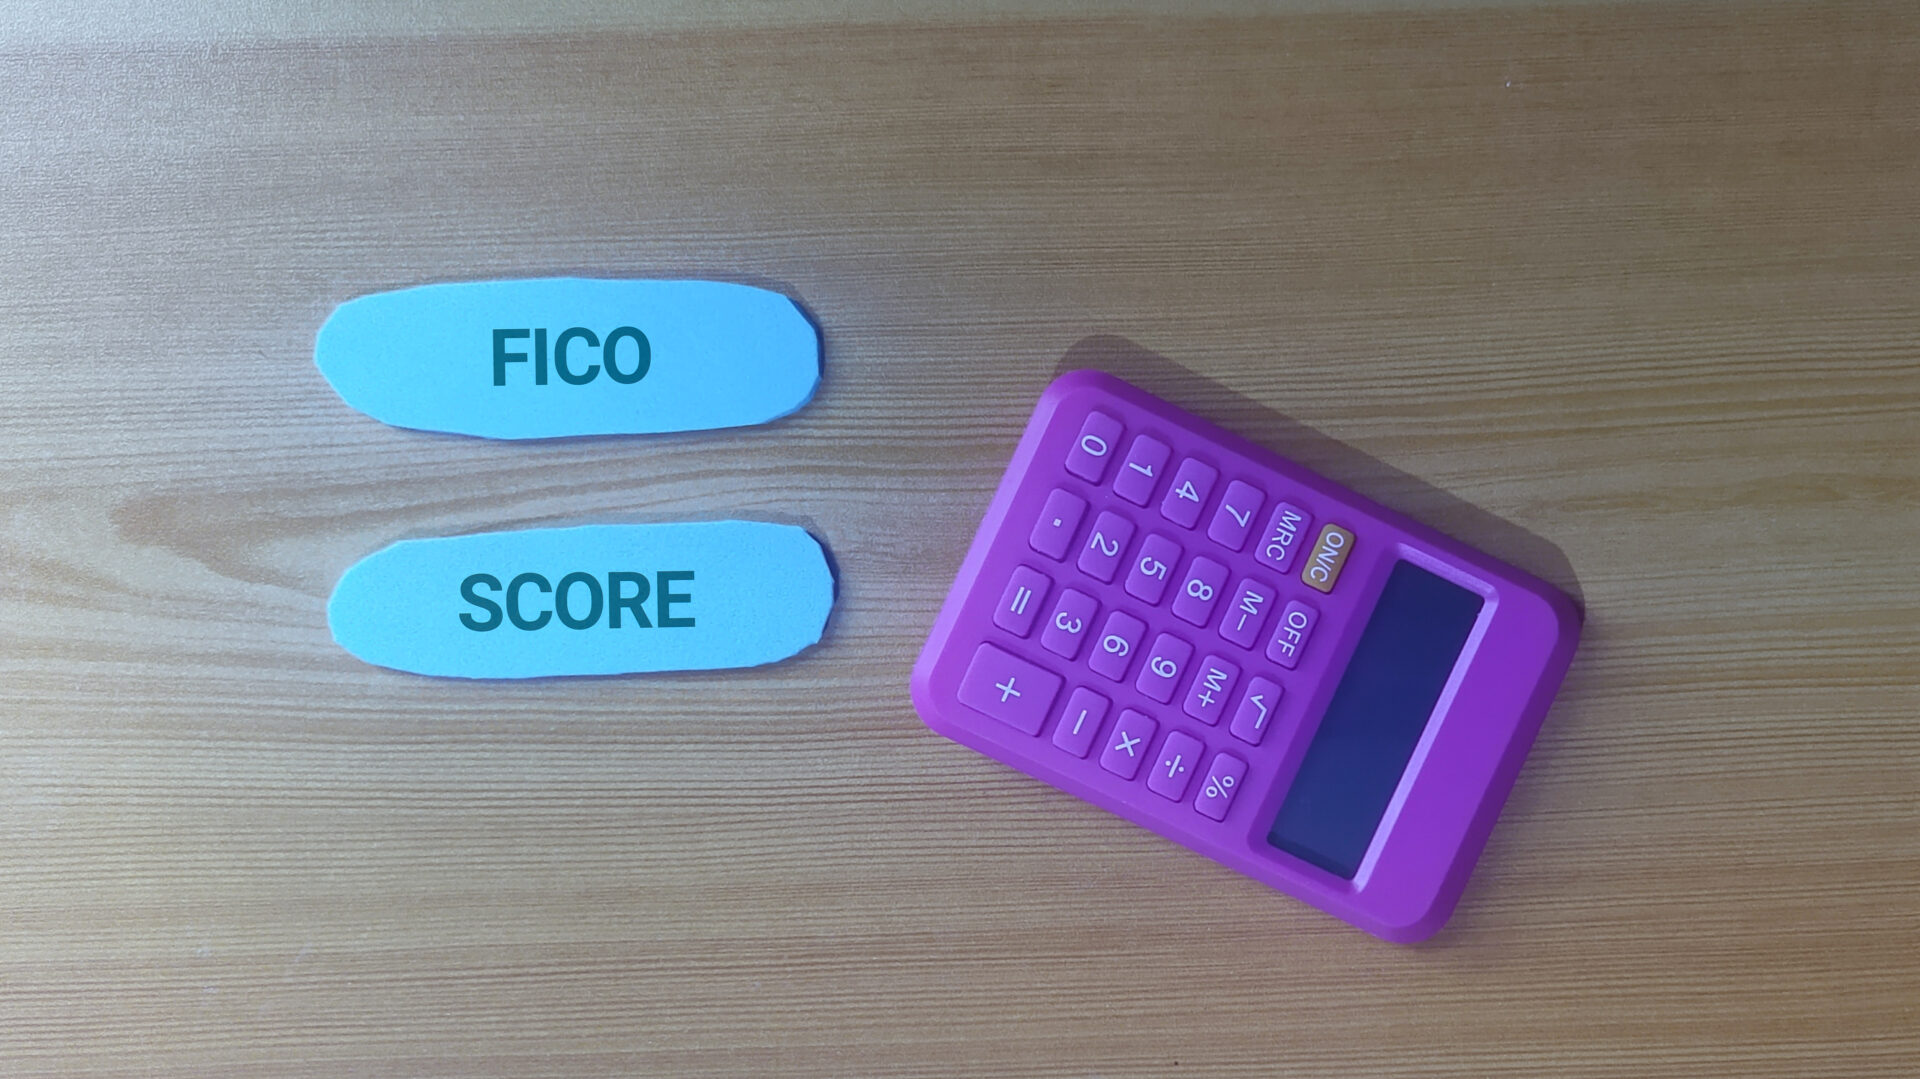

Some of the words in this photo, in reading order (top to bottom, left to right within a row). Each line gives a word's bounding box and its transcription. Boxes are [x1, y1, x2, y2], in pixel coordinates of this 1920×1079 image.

[1081, 434, 1108, 456] 0
[1128, 461, 1153, 478] 1
[1174, 480, 1200, 502] 4
[1225, 504, 1251, 528] 7
[1090, 531, 1119, 557] 2
[1265, 510, 1302, 562] MRC
[1140, 556, 1167, 580] 5
[1310, 531, 1345, 583] ON/C
[1186, 579, 1213, 602] 8
[1055, 611, 1082, 634] 3
[1277, 611, 1308, 658] OFF
[1103, 635, 1129, 657] 6
[1150, 656, 1177, 678] 9
[1197, 667, 1228, 708] M+
[1205, 775, 1235, 799] %
